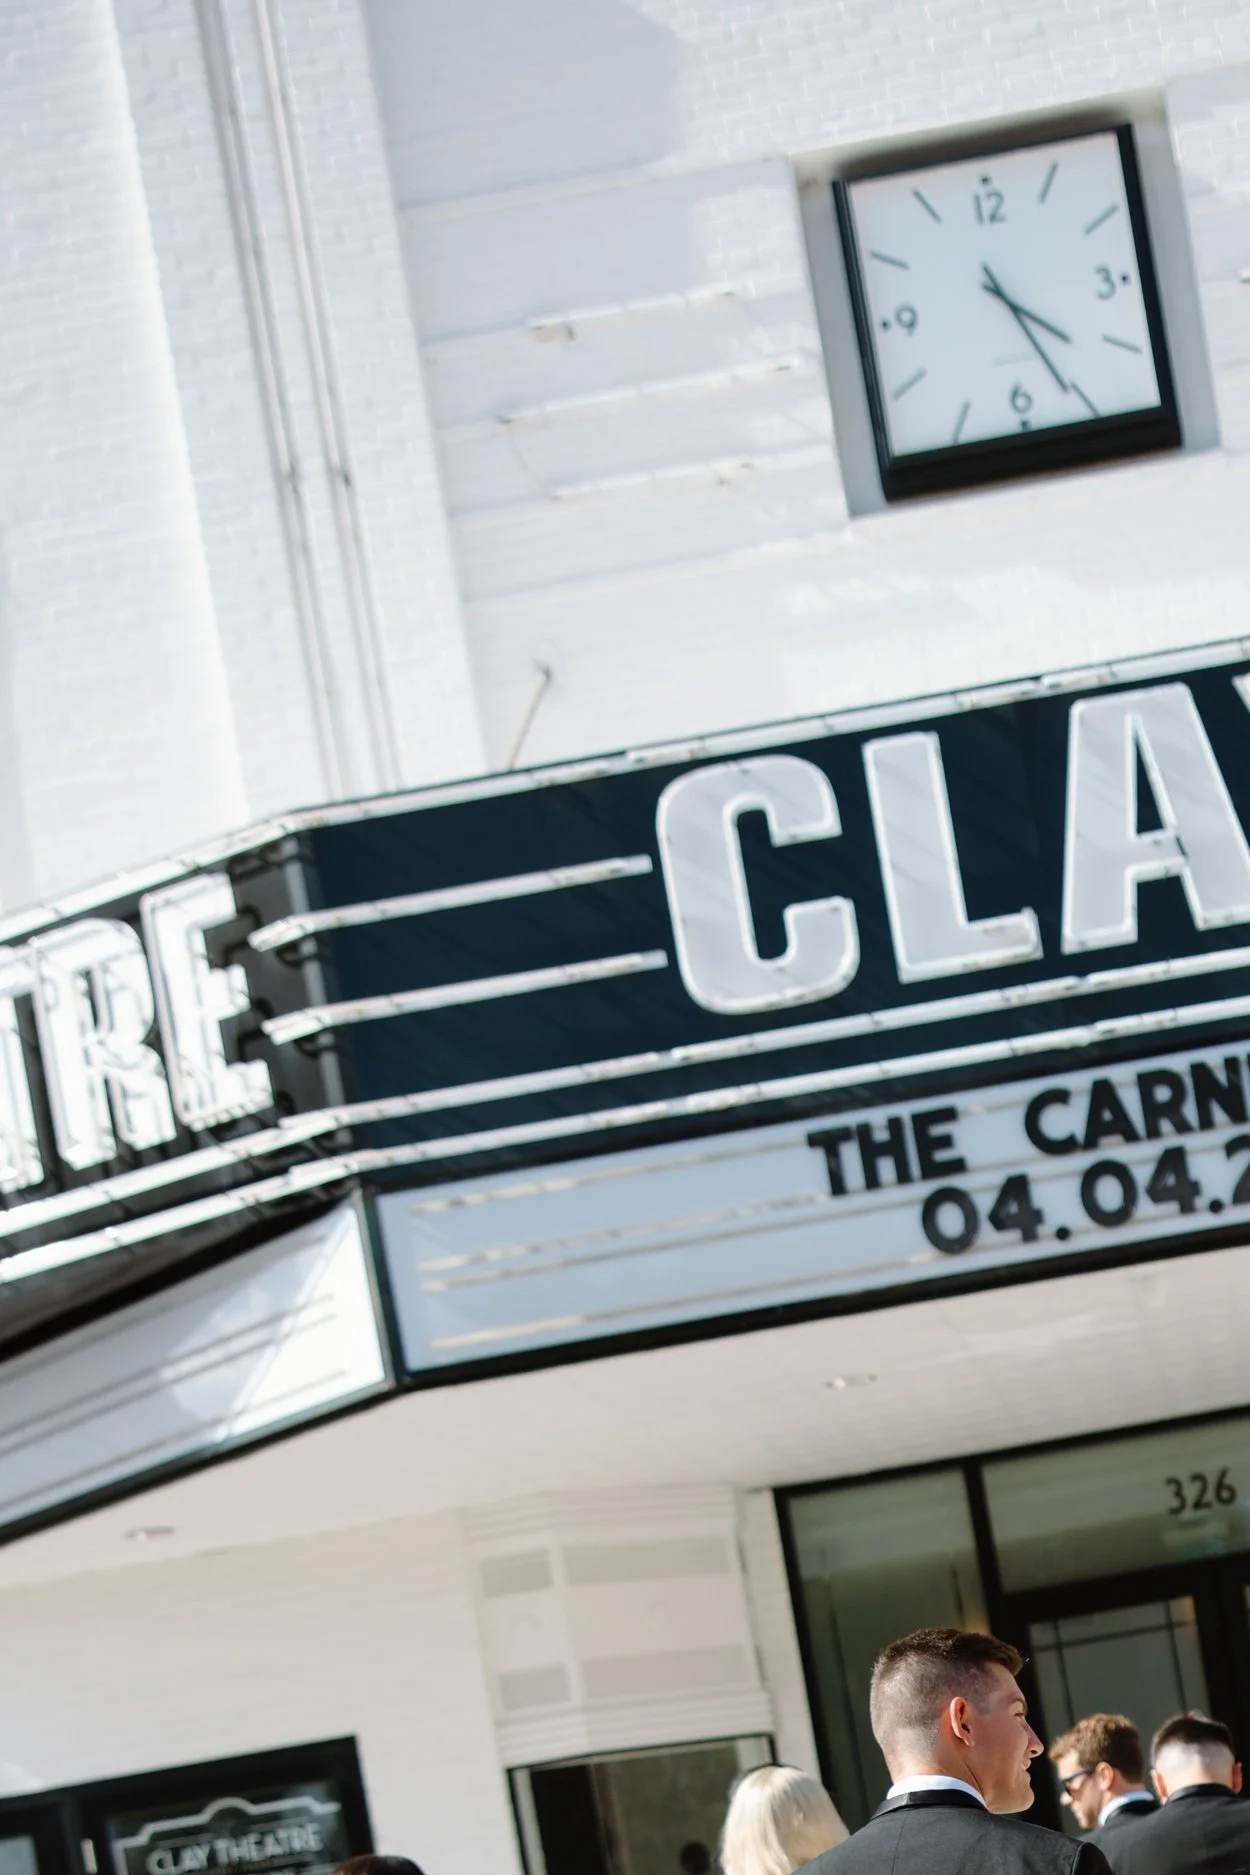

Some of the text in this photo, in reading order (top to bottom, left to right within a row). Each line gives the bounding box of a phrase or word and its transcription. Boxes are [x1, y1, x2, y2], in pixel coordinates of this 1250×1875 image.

[972, 191, 1007, 226] 12
[1094, 265, 1117, 300] 3
[895, 304, 918, 336] 9
[1009, 382, 1034, 415] 6
[0, 871, 274, 1195] TRE
[806, 1105, 968, 1196] THE
[1165, 1466, 1237, 1516] 326
[212, 1822, 325, 1867] THEATRE
